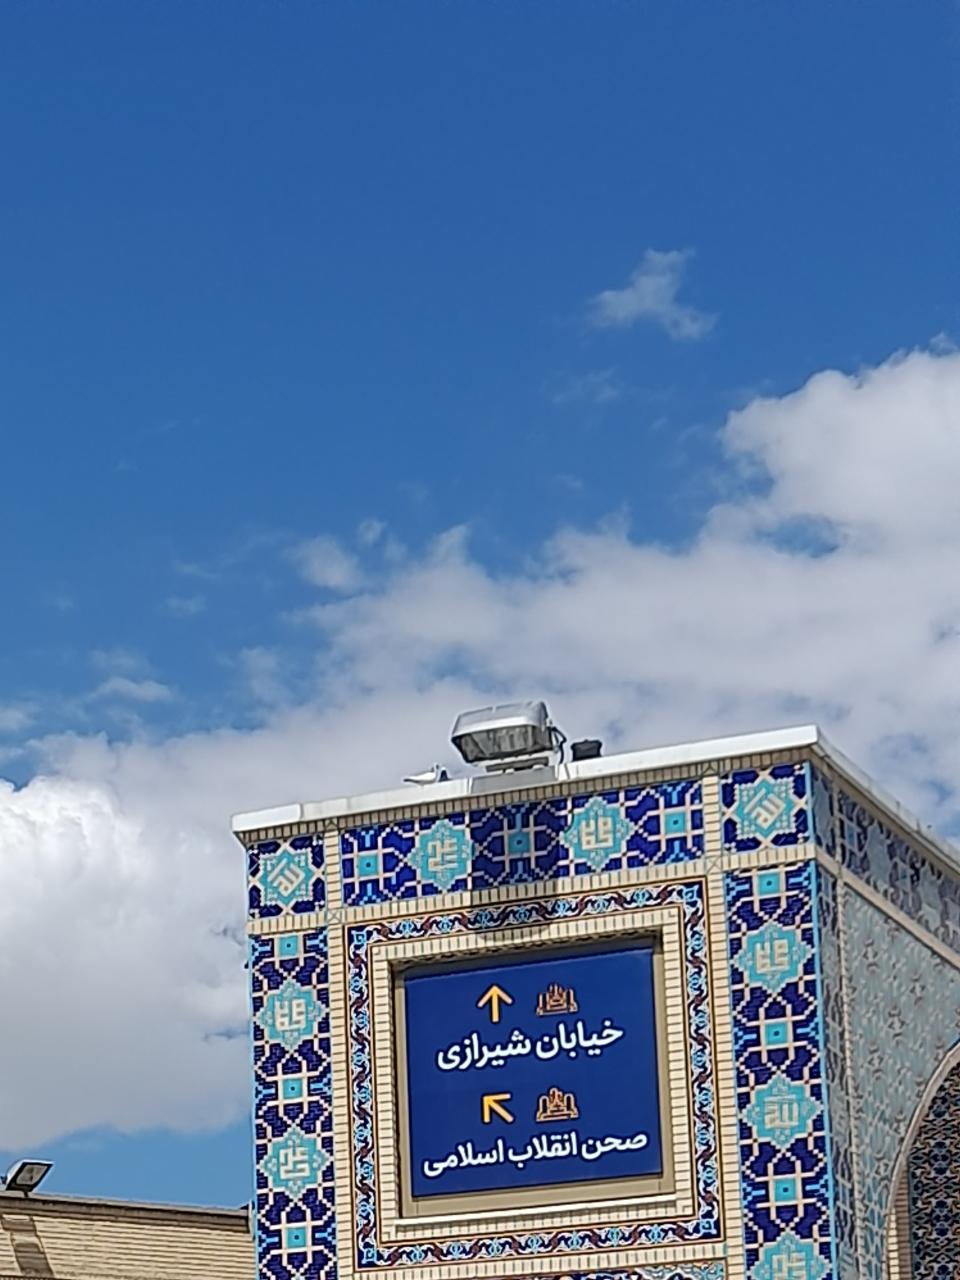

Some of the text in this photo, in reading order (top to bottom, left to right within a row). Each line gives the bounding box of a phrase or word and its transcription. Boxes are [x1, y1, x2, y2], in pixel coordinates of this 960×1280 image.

[437, 1019, 623, 1070] خیابان شیرازی
[423, 1131, 648, 1177] صحن انقلاب اسلامی
